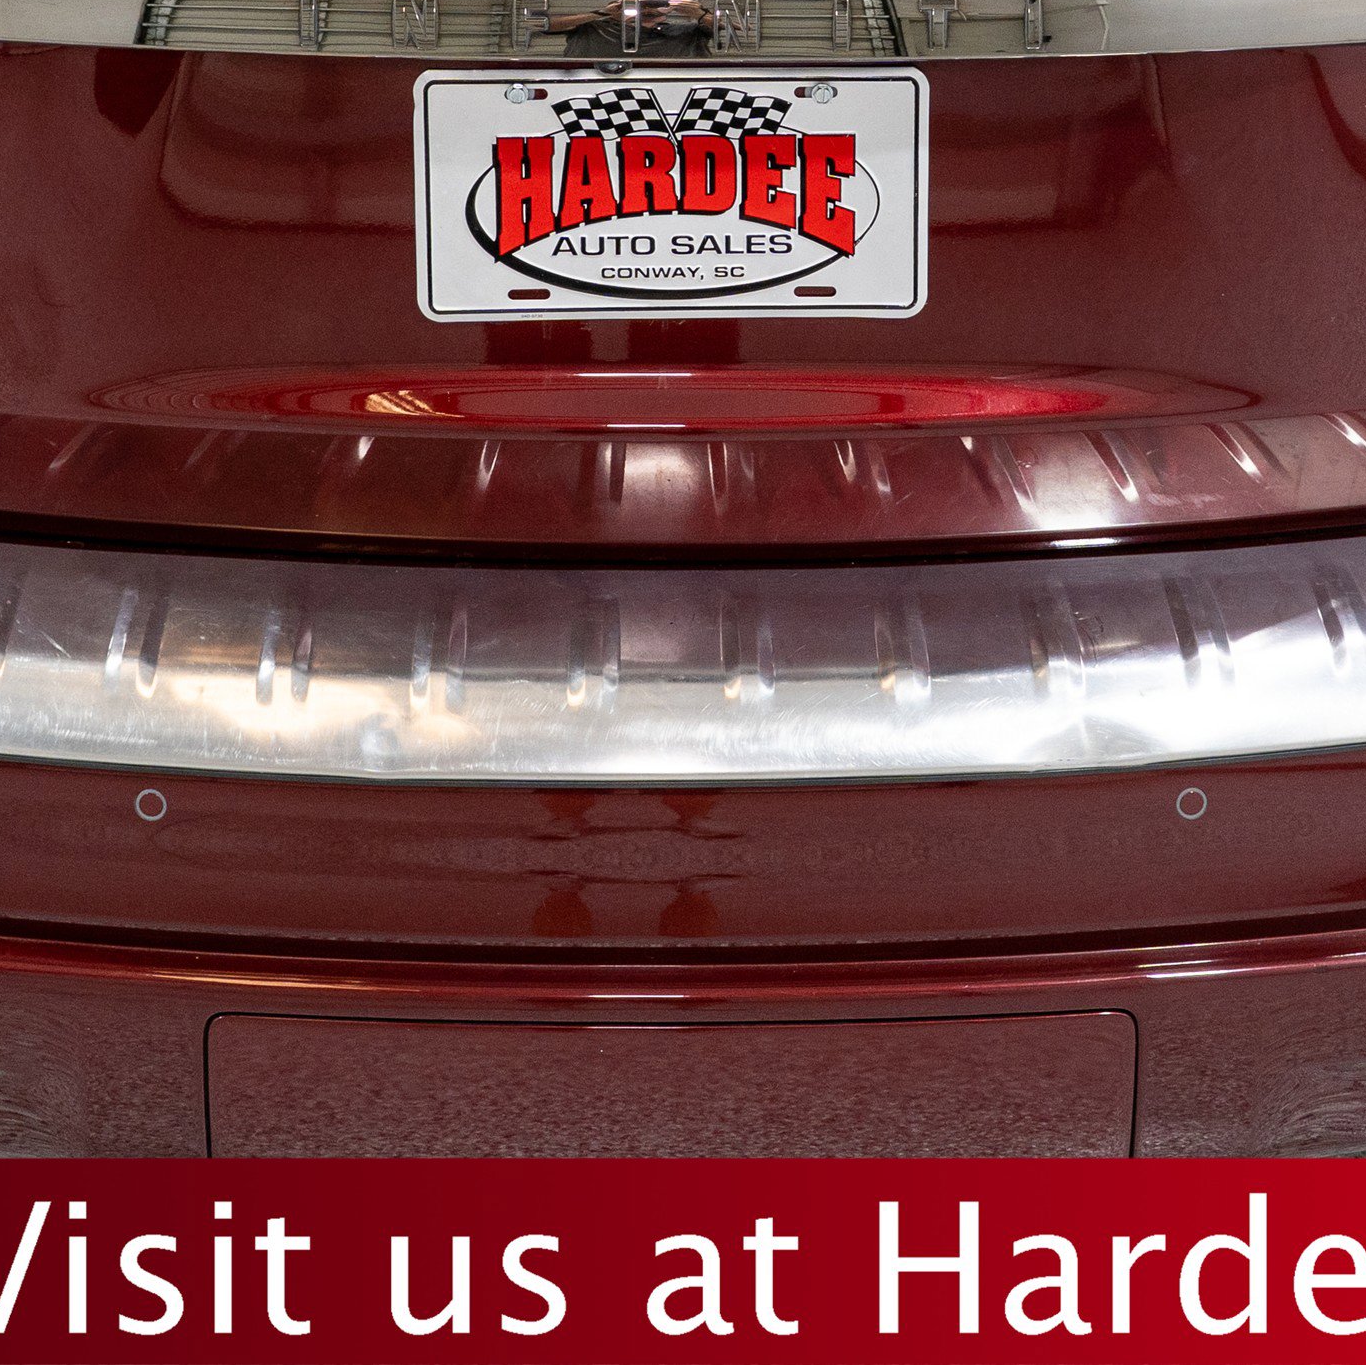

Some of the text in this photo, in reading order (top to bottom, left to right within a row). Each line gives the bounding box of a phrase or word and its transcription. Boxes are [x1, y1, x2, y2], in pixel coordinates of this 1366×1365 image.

[492, 134, 856, 263] HARDEE
[552, 233, 793, 257] AUTO SALES
[600, 265, 746, 281] CONWAY, SC
